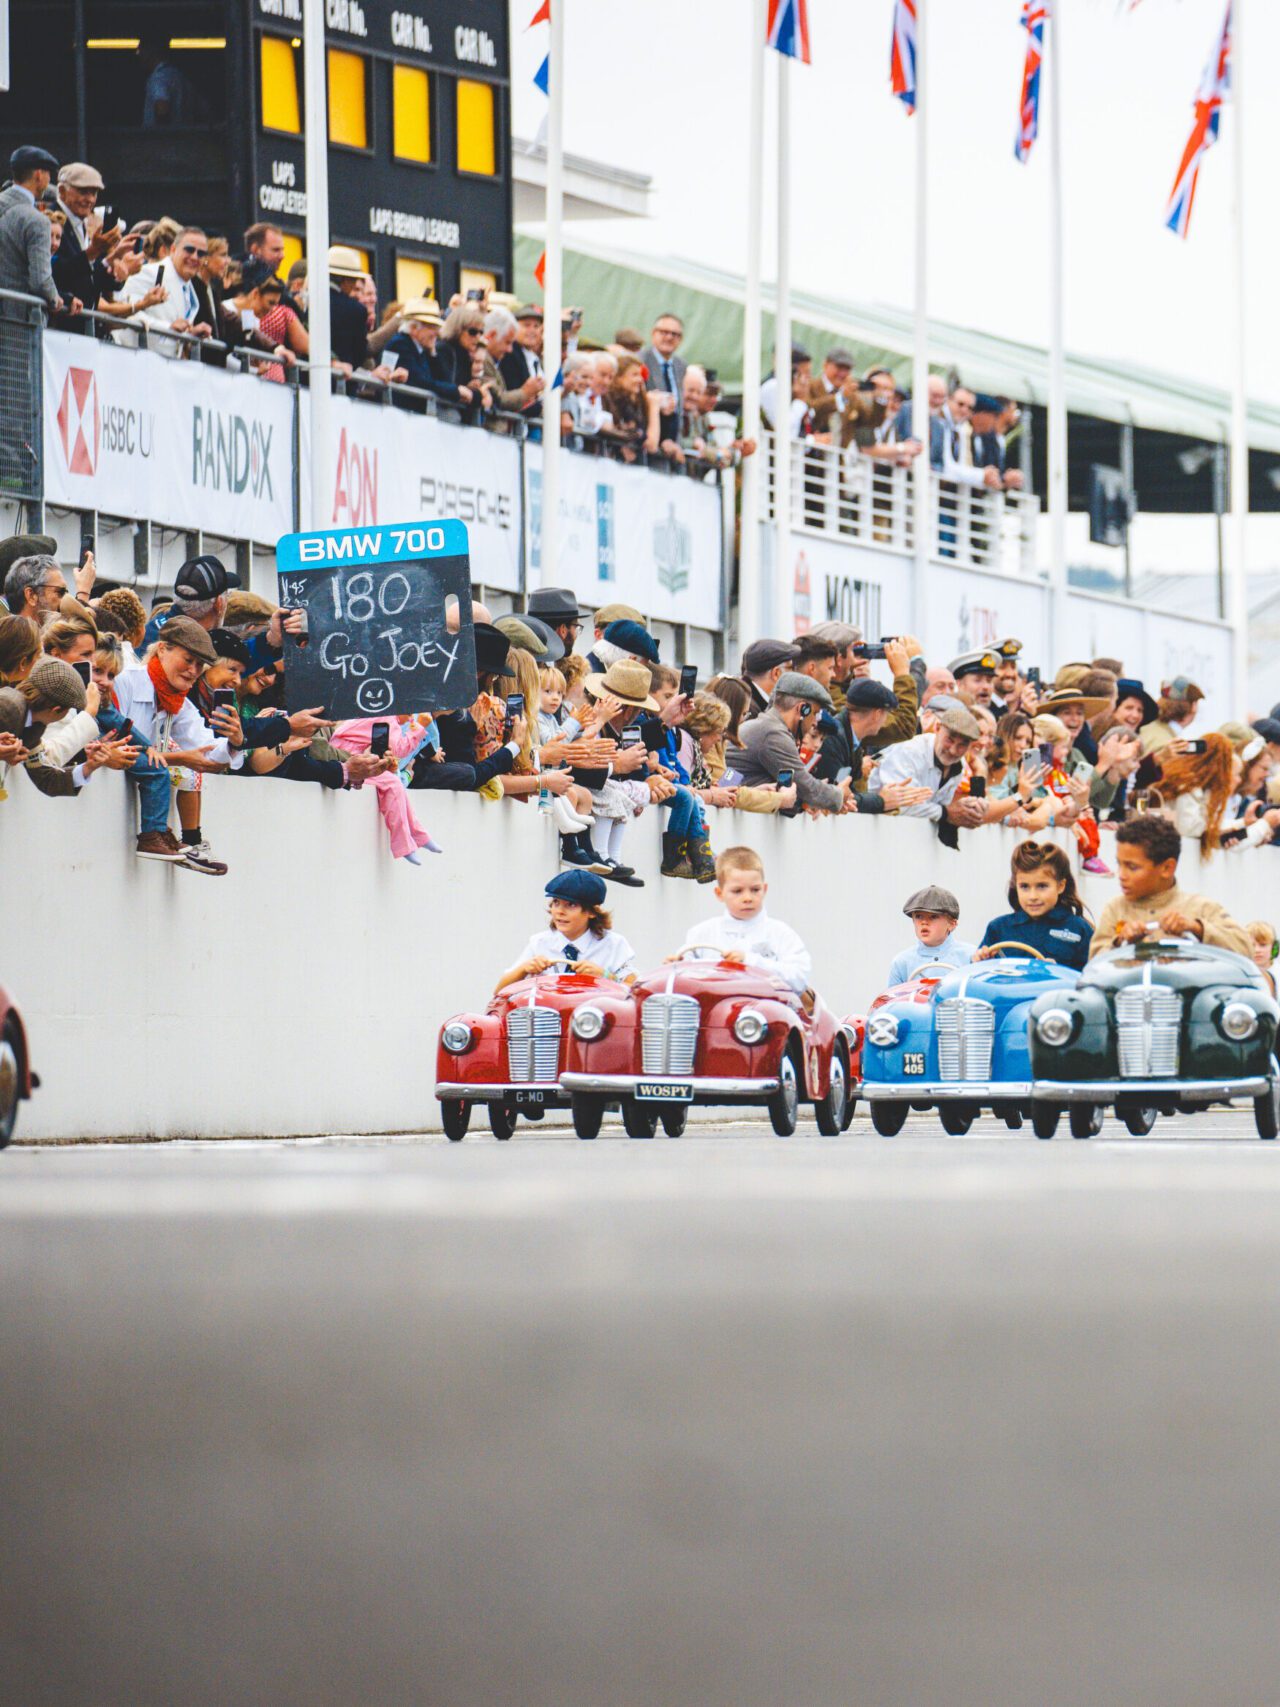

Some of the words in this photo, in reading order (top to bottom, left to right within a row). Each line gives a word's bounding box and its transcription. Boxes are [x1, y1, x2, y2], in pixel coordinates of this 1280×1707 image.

[391, 10, 414, 47] CAR
[414, 16, 433, 53] No.
[454, 25, 479, 62] CAR
[479, 31, 498, 67] No.
[272, 160, 296, 187] LAPS
[370, 206, 393, 236] LAPS
[393, 211, 426, 242] BEHIND
[426, 217, 460, 249] LEADER
[103, 404, 136, 455] HSBC
[192, 405, 274, 502] RANDOX
[332, 426, 378, 527] AON
[299, 532, 382, 562] BMW
[390, 527, 445, 554] 700
[331, 571, 411, 622] 180
[903, 1053, 924, 1064] TVC
[903, 1063, 924, 1075] 405
[639, 1084, 689, 1098] WOSPY
